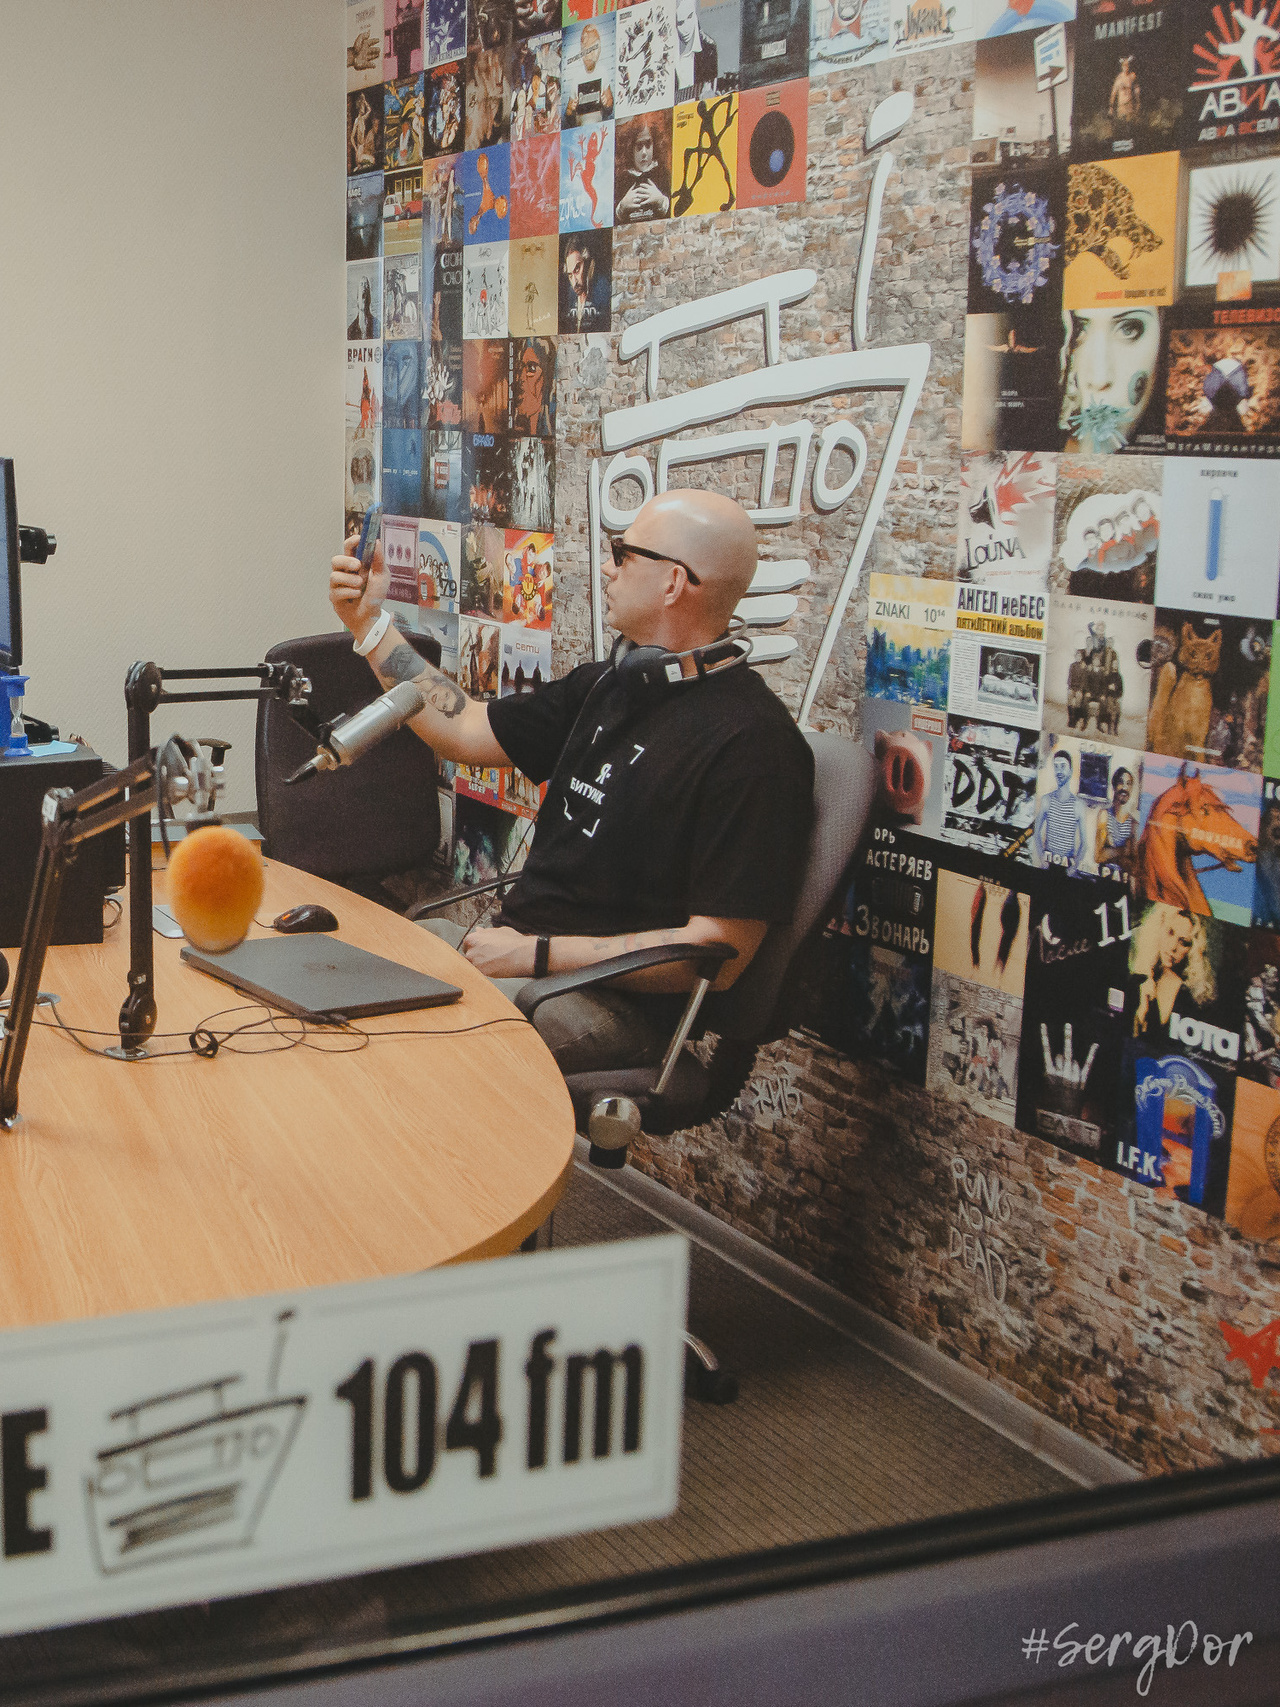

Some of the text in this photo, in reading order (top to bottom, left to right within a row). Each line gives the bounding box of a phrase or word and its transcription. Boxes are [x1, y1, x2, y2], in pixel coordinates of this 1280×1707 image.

[875, 601, 910, 620] ZNAKI
[957, 587, 998, 614] АНГЕЛ
[866, 848, 933, 881] АСТЕРЯЕВ
[335, 1334, 505, 1505] 104
[522, 1326, 647, 1473] fm
